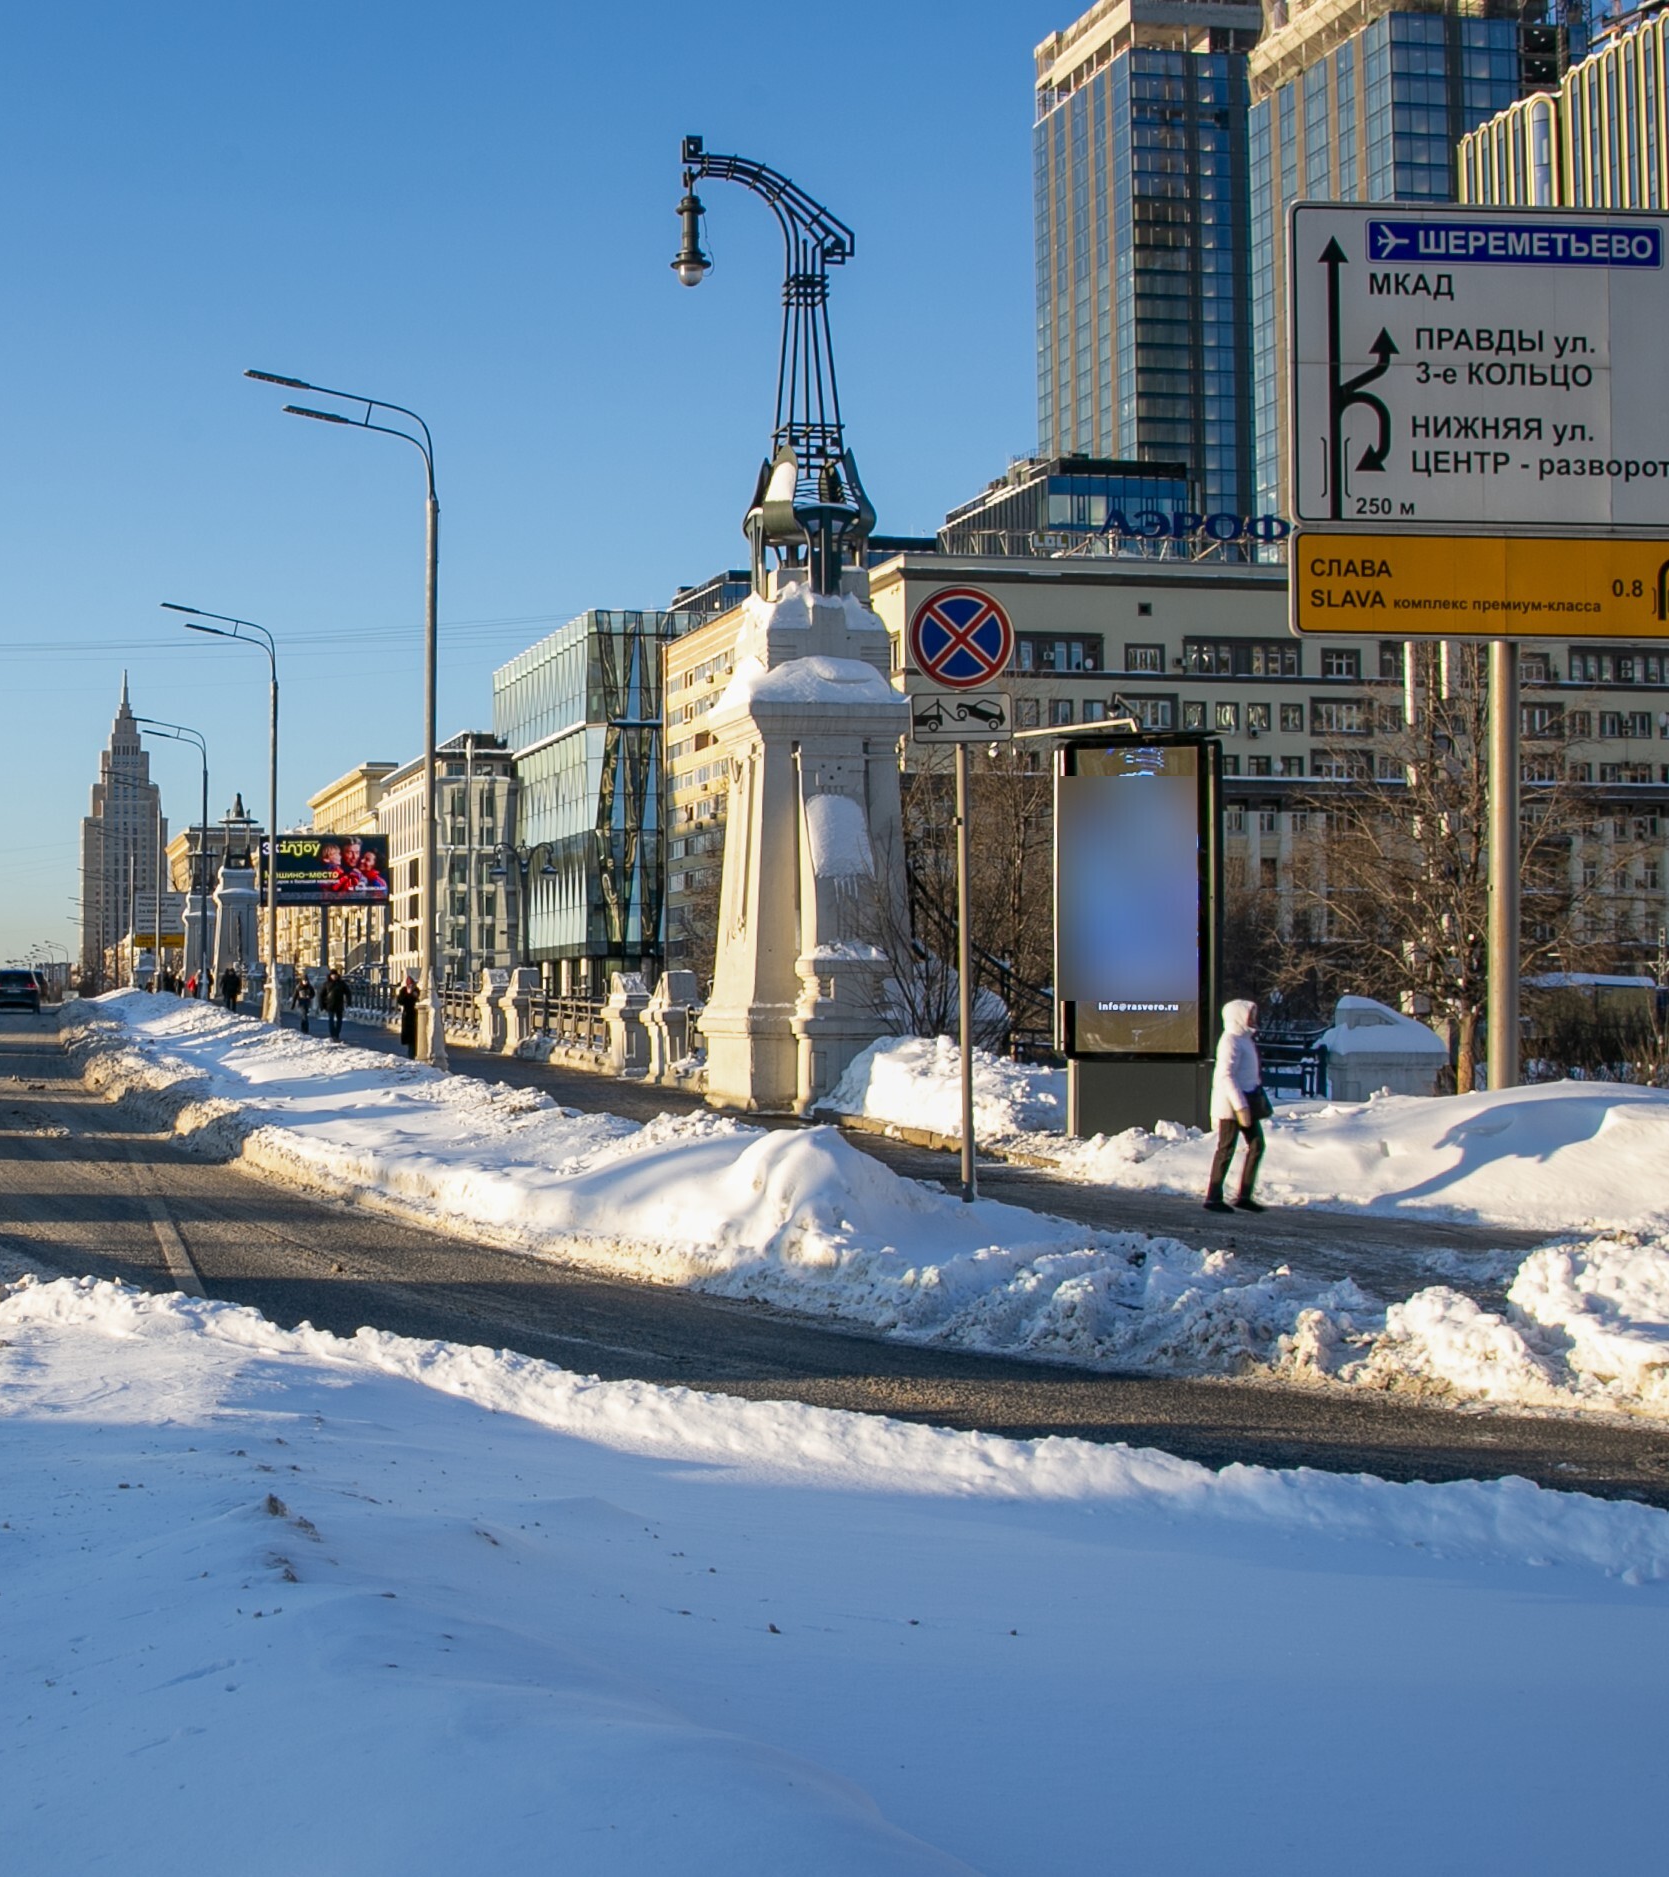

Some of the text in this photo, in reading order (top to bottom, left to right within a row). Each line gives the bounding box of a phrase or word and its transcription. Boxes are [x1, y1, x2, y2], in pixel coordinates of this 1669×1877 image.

[1418, 230, 1653, 259] ШЕРЕМЕТЬЕВО
[1369, 272, 1454, 300] МКАД
[1416, 327, 1595, 359] ПРАВДЫ ул.
[1416, 361, 1592, 391] 3-е КОЛЬЦО
[1412, 415, 1594, 447] НИЖНЯЯ ул.
[1412, 450, 1510, 478] ЦЕНТР
[1539, 458, 1669, 482] разворот
[1356, 497, 1415, 516] 250 м
[1099, 508, 1291, 543] АЭРОФ
[1310, 558, 1393, 578] СЛАВА
[1310, 589, 1386, 609] SLAVA
[1612, 578, 1644, 598] 0.8
[1393, 598, 1602, 615] комплекс премиум-класса
[279, 841, 321, 857] injoy
[264, 870, 339, 880] Мшино-место
